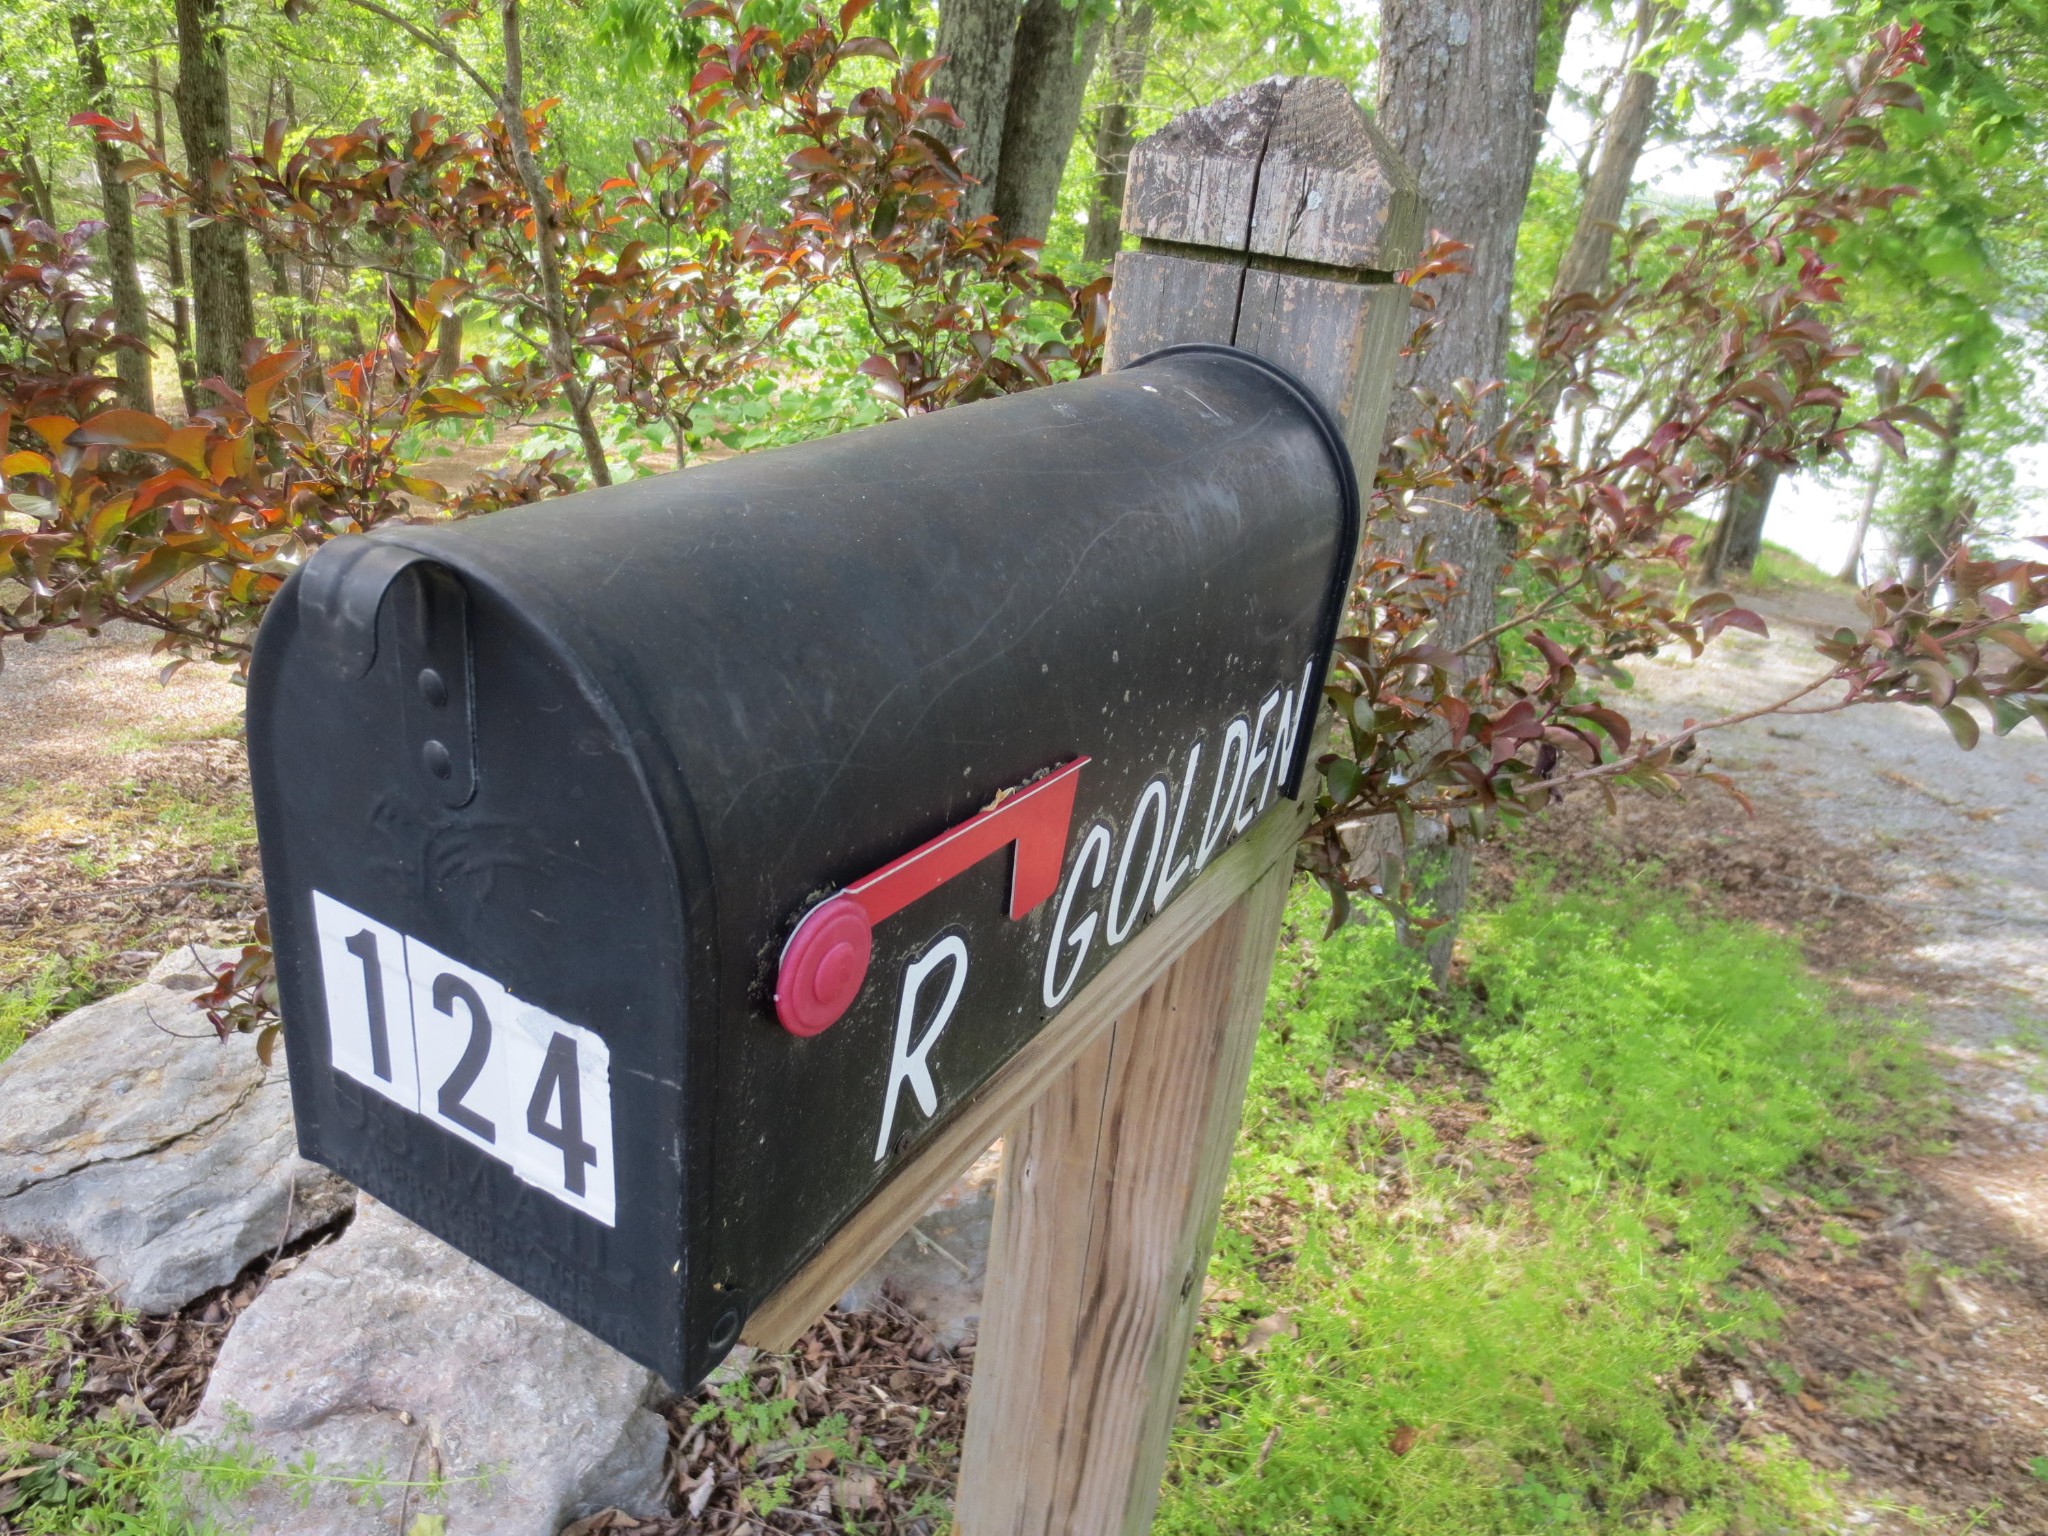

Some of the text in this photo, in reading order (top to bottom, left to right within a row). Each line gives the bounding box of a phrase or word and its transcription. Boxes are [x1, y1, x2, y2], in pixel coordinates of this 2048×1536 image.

[345, 927, 598, 1199] 124
[874, 661, 1313, 1162] R GOLDEN
